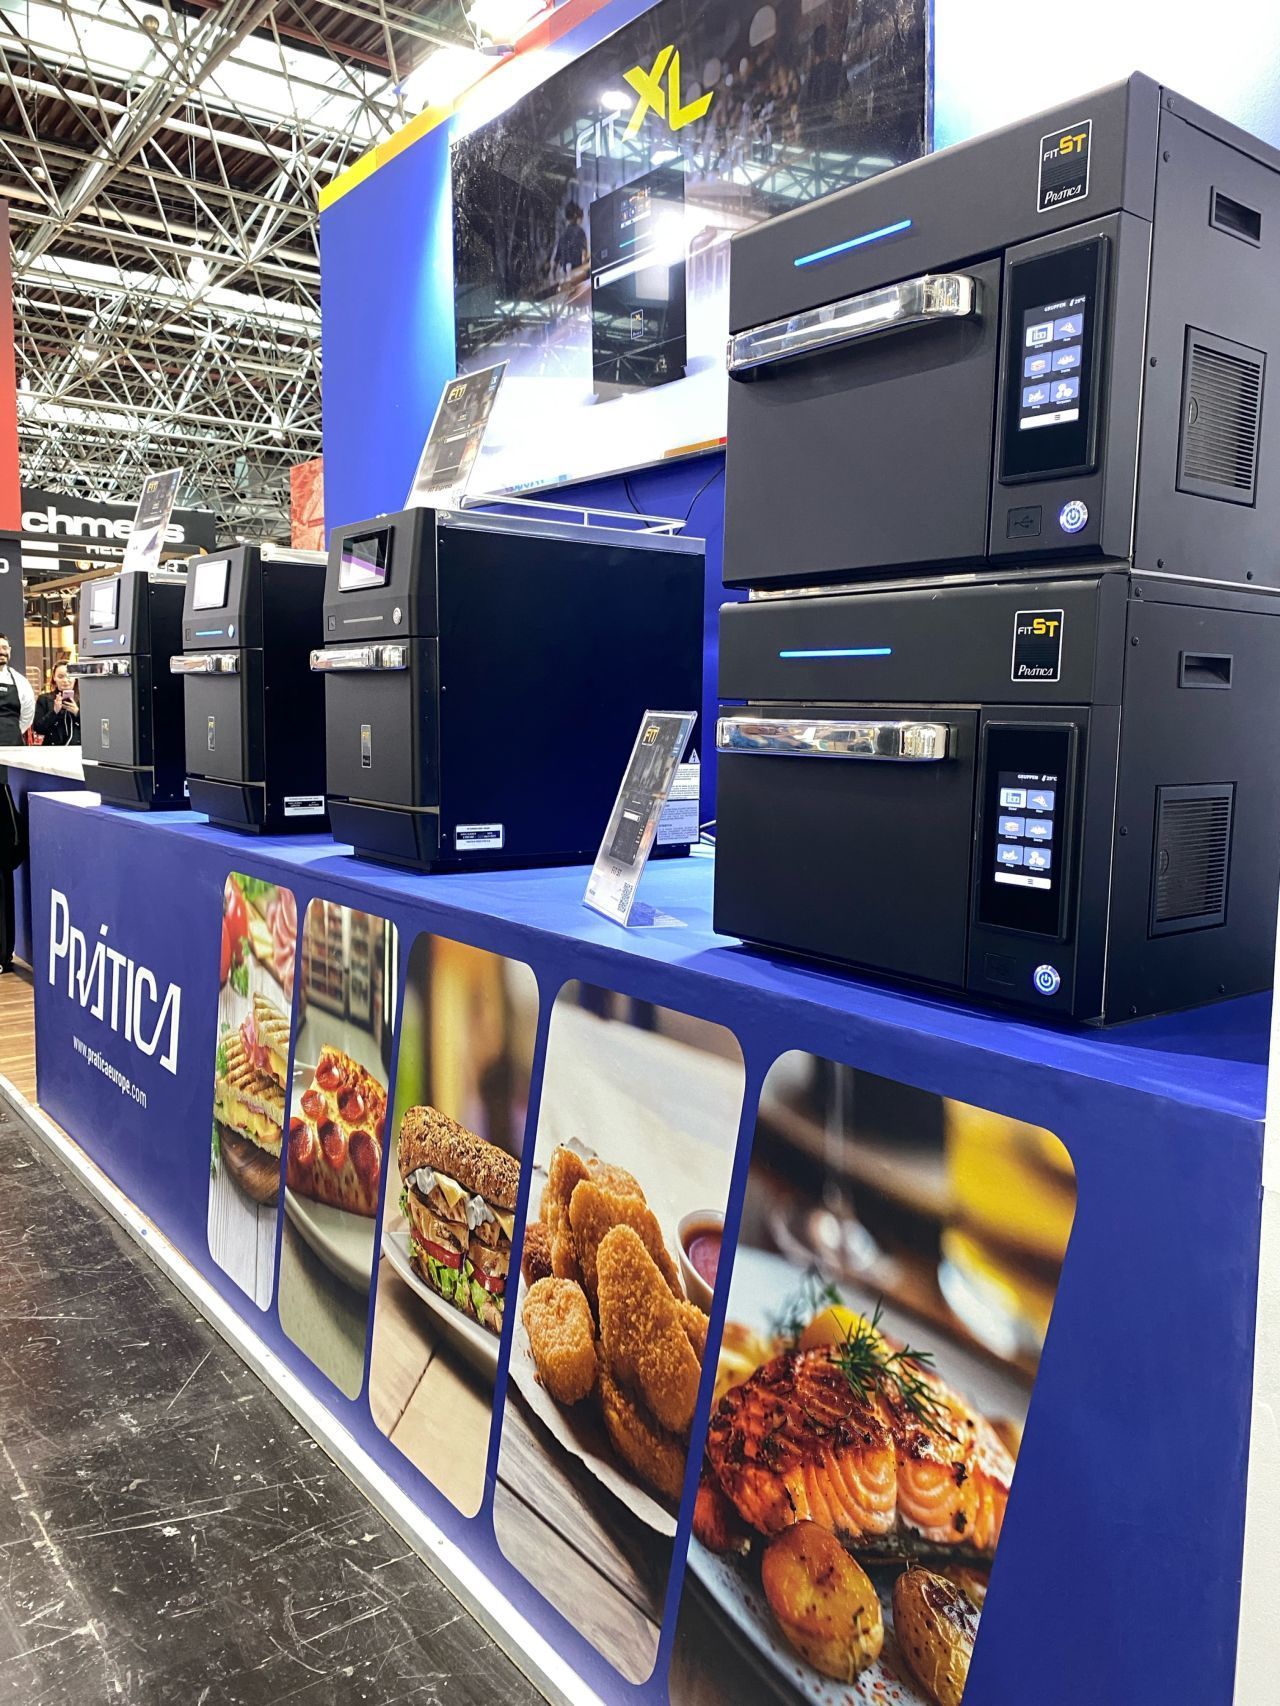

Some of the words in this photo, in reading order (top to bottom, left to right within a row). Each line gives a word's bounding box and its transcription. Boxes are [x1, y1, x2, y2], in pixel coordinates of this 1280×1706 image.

[576, 109, 621, 168] FIT
[622, 44, 714, 144] XL
[73, 1035, 147, 1109] www.praticaeurope.com
